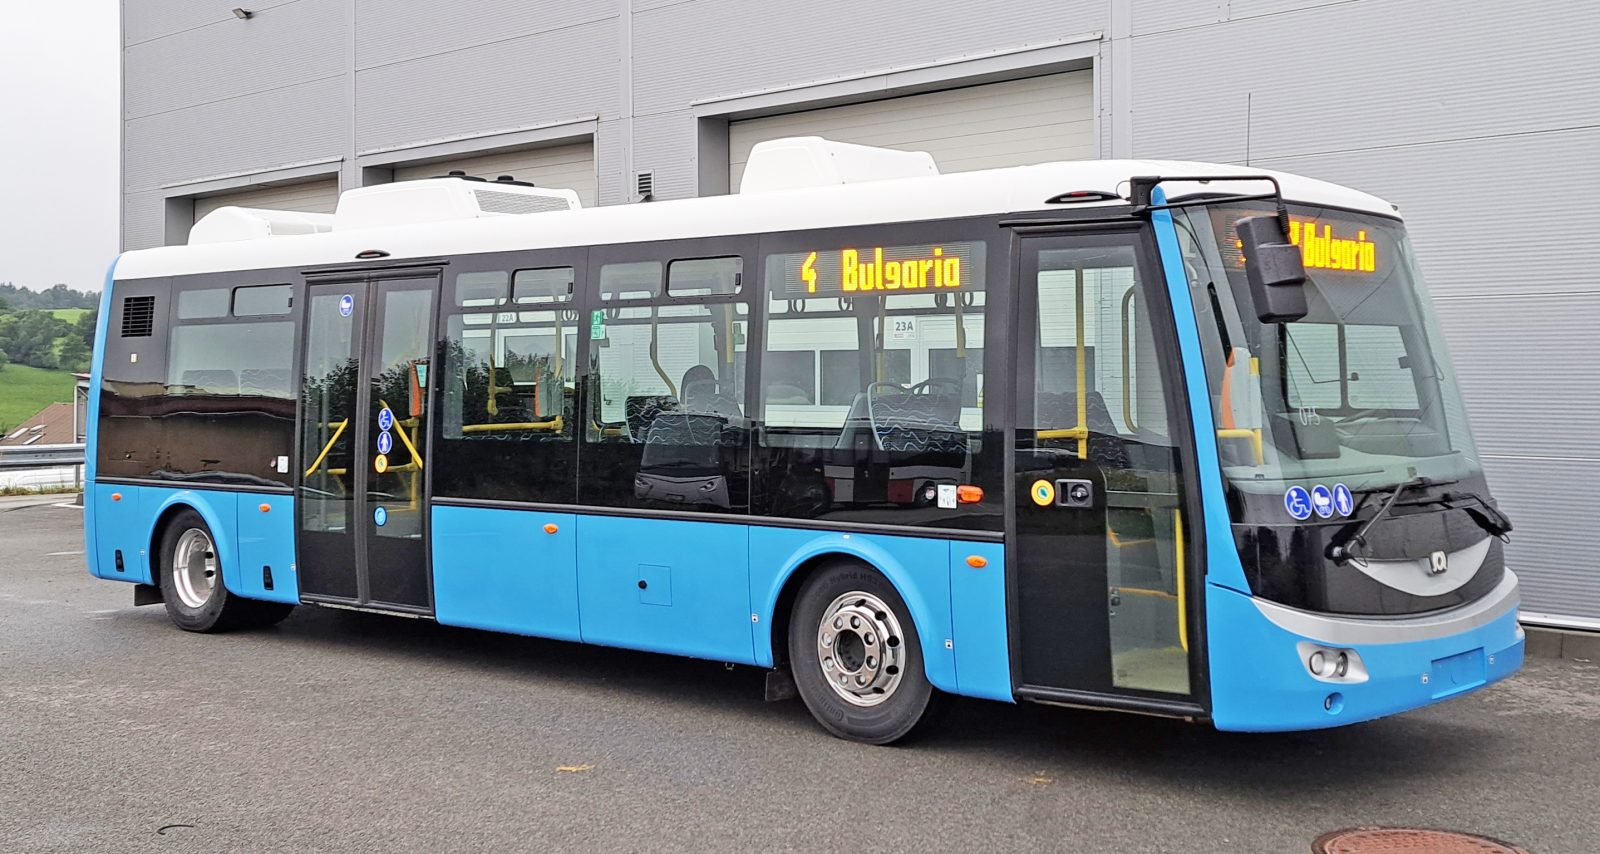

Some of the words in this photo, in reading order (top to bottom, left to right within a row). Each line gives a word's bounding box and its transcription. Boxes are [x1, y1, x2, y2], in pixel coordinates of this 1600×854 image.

[1303, 222, 1375, 272] Bulgaria
[802, 251, 817, 293] 4
[842, 247, 960, 292] Bulgaria
[502, 313, 514, 322] 22A
[895, 320, 914, 332] 23A
